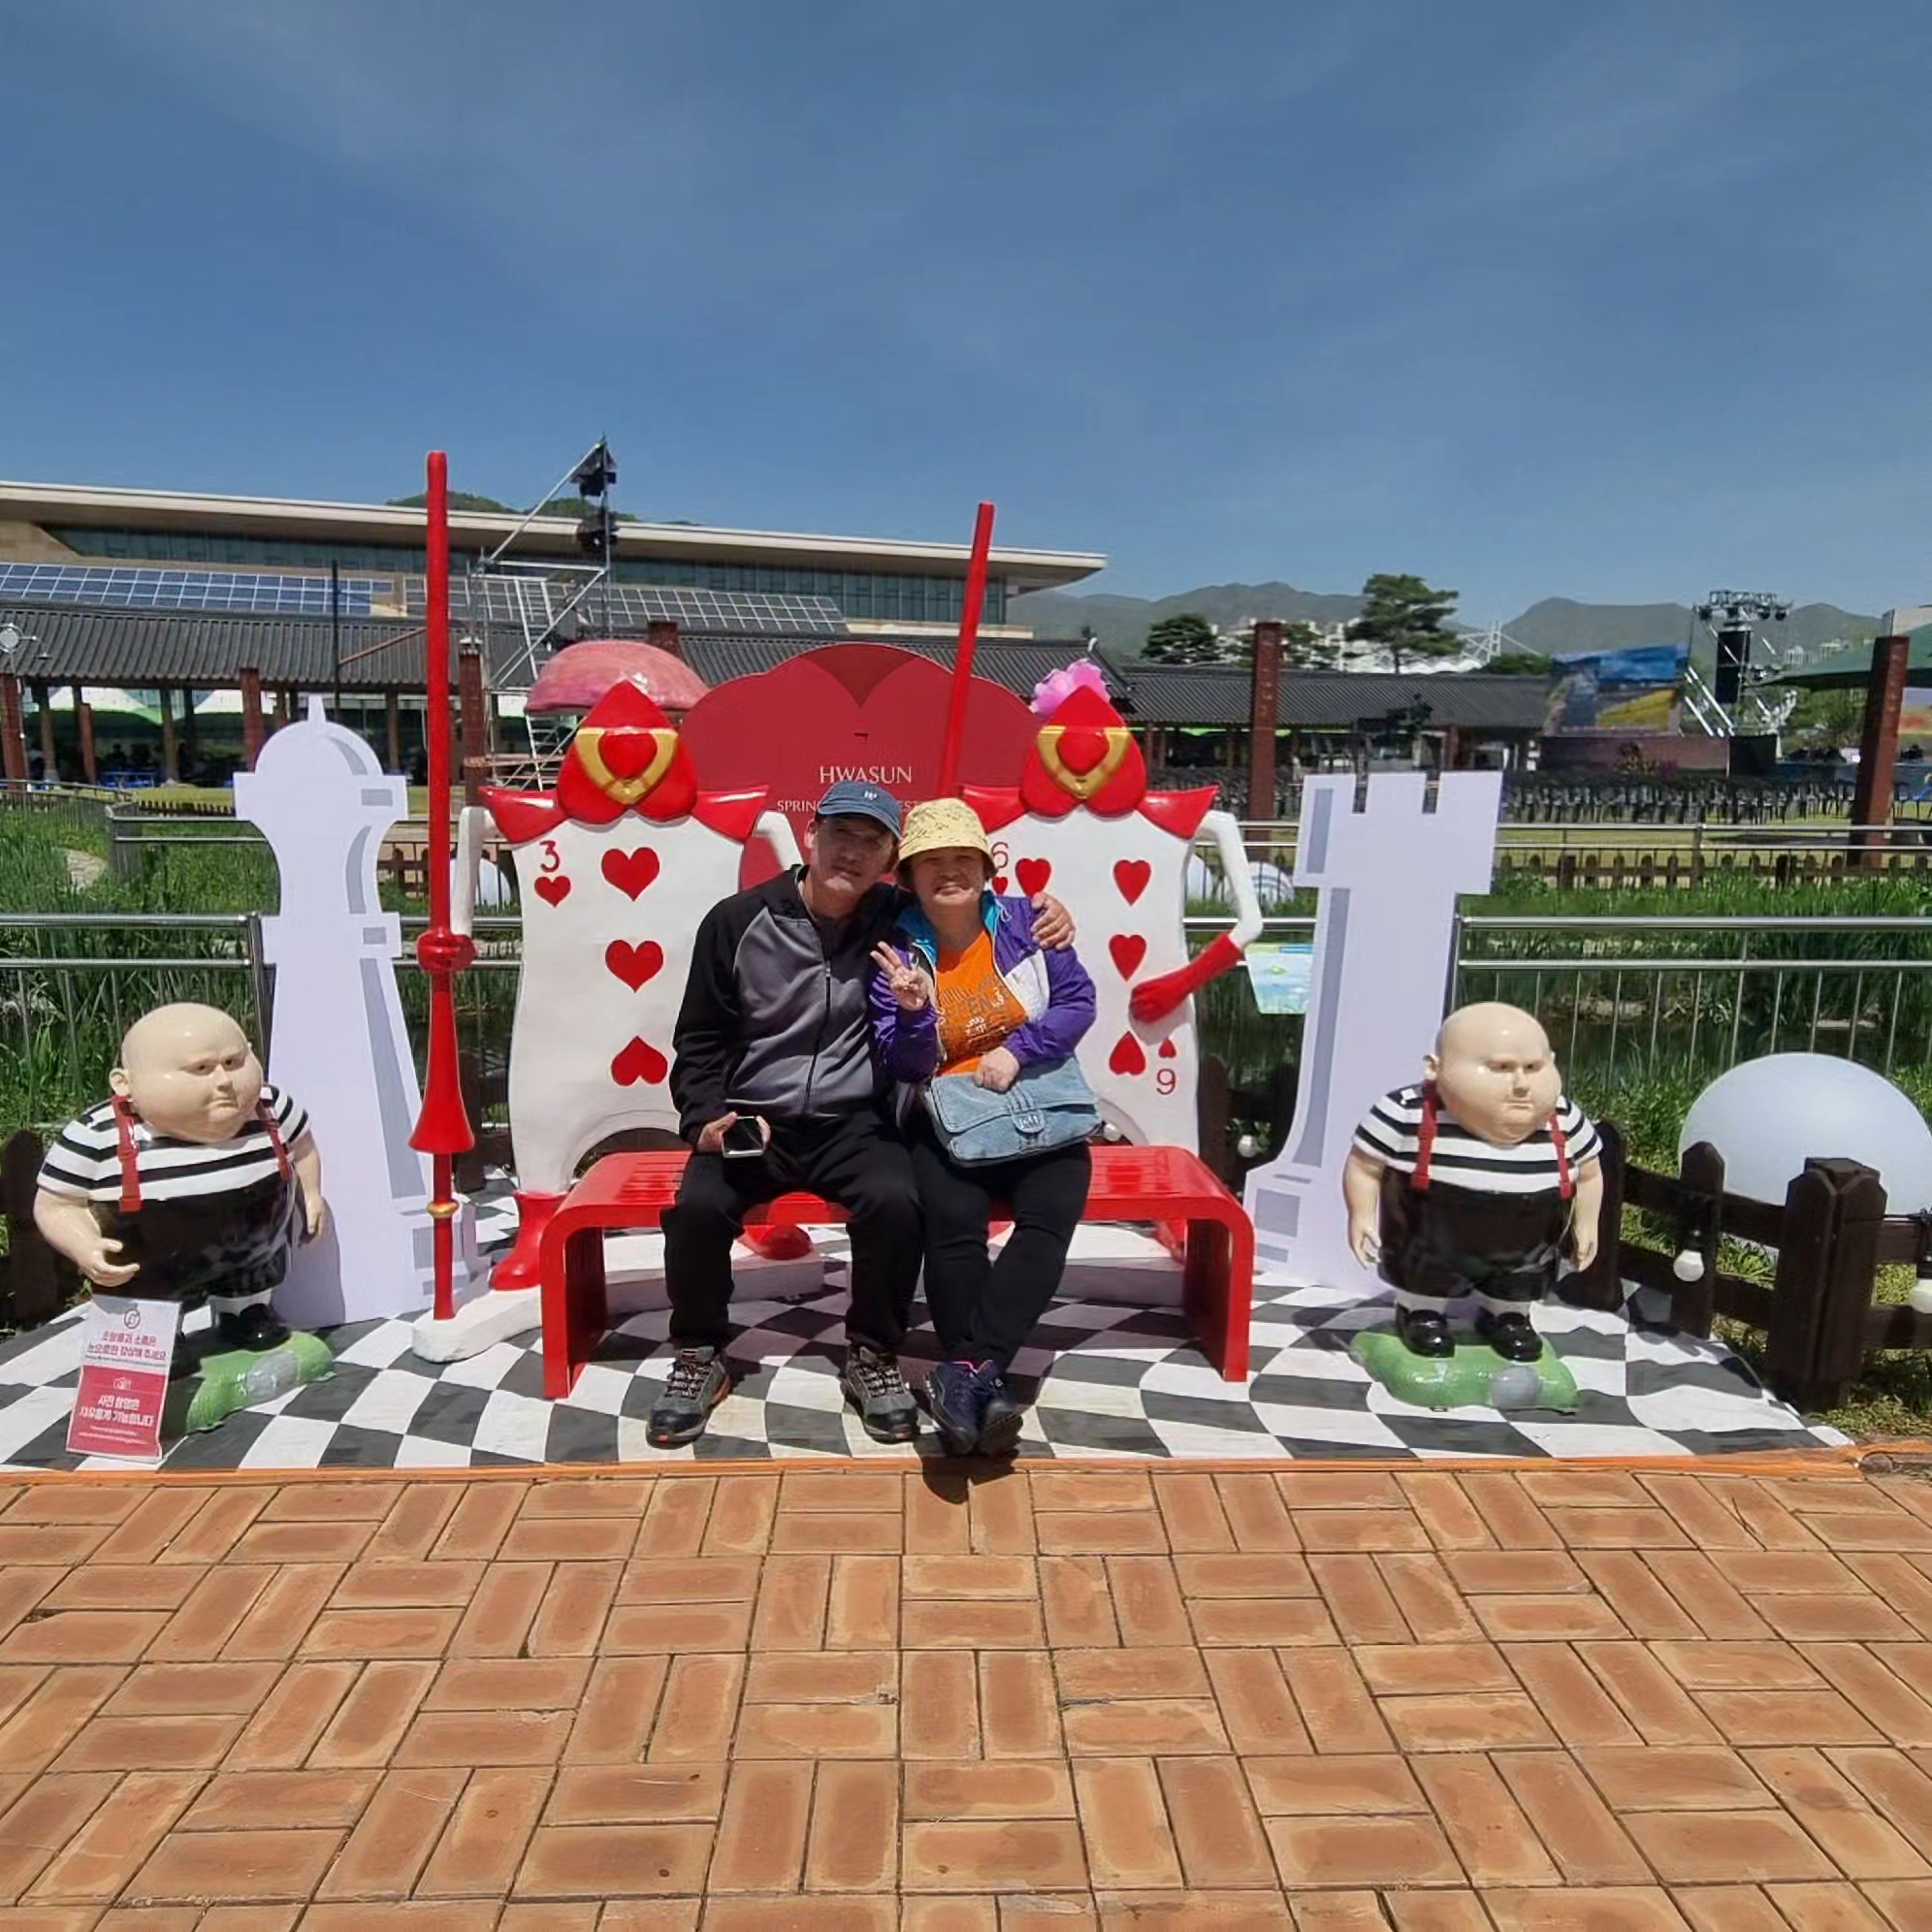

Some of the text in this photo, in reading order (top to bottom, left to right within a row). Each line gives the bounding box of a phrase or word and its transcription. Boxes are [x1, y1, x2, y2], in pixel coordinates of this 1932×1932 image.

[820, 765, 913, 785] HWASUN
[777, 799, 817, 813] SPRIN
[539, 840, 561, 873] 3
[990, 841, 1009, 869] 6
